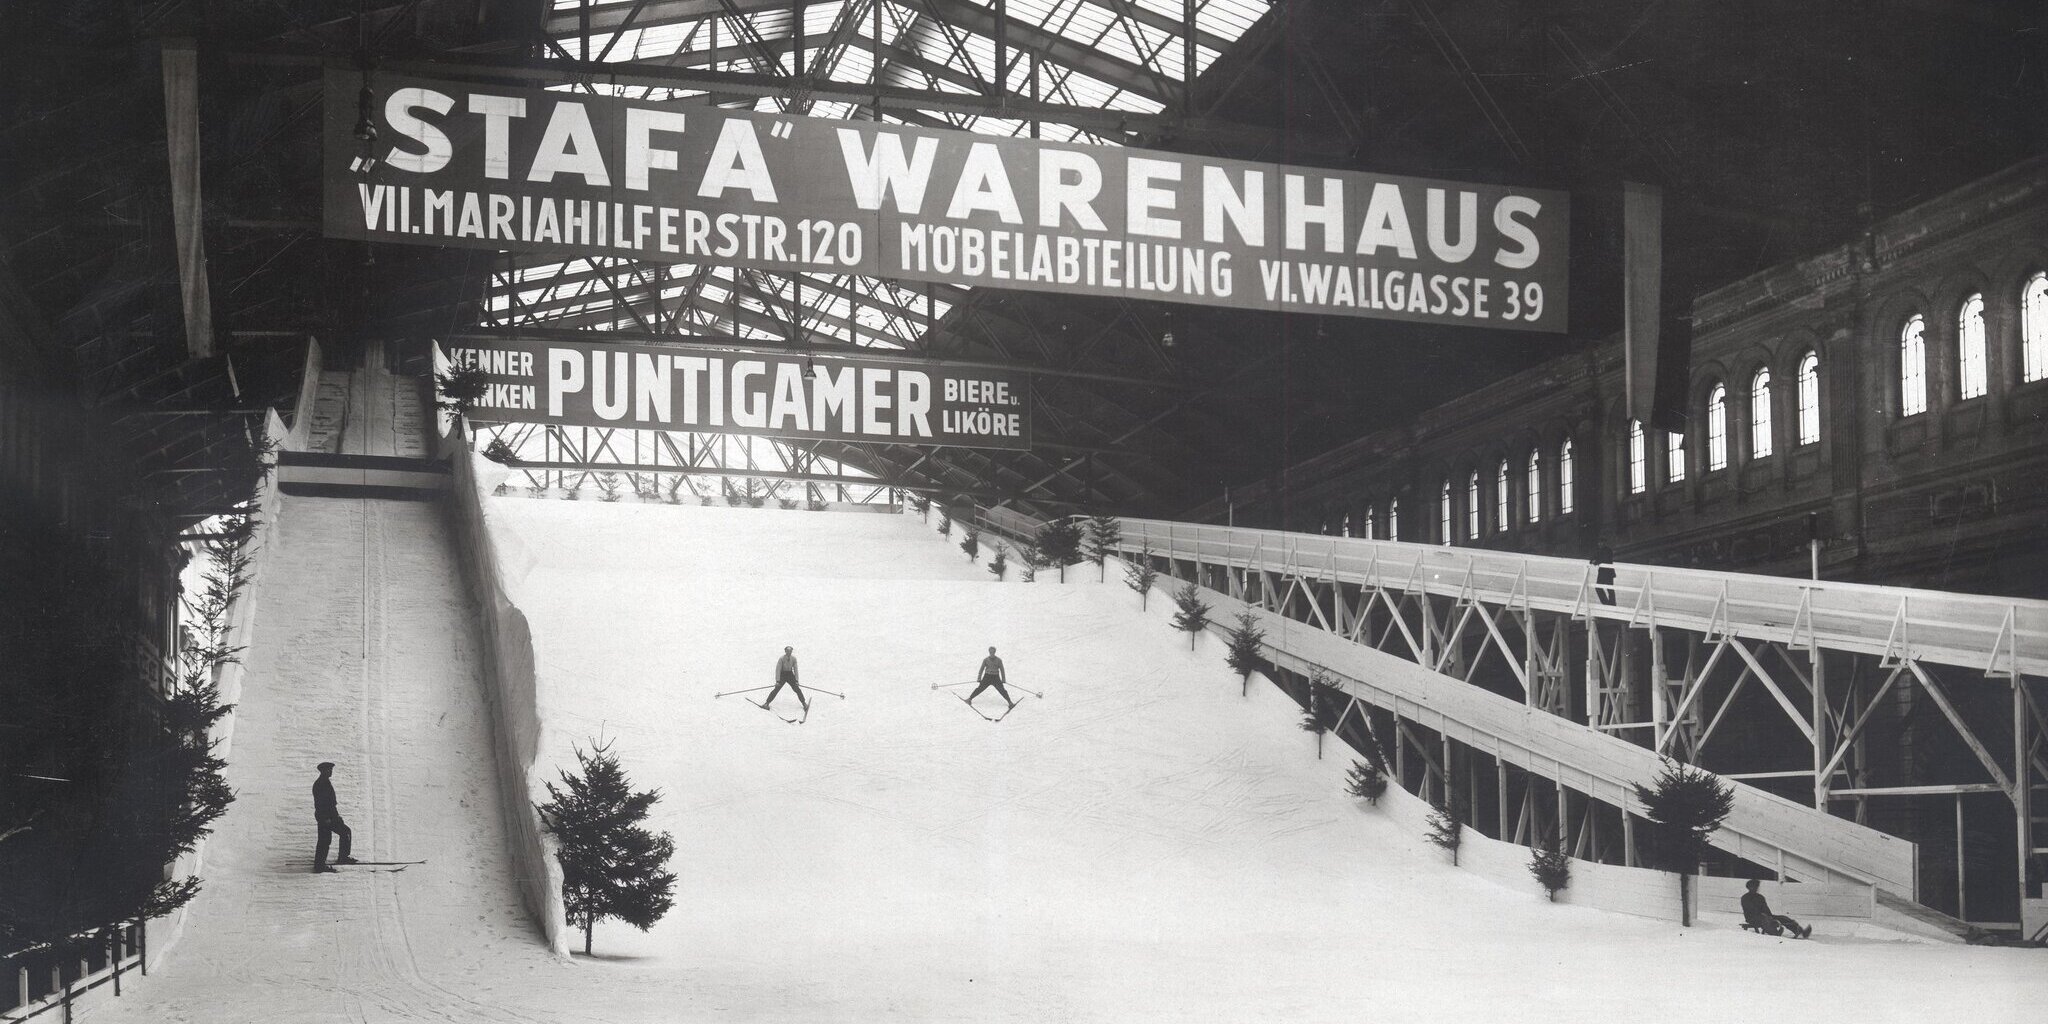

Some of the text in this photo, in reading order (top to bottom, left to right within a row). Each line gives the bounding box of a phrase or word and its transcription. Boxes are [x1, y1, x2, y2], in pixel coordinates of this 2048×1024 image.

[836, 127, 1542, 270] WARENHAUS
[900, 221, 1233, 298] MÖBELABTEILUNG
[1502, 280, 1544, 322] 39
[450, 347, 534, 377] KENNER
[472, 382, 536, 410] NKEN
[548, 347, 933, 438] PUNTIGAMER
[944, 378, 1009, 405] BIERE
[942, 407, 1020, 437] LIKÖRE
